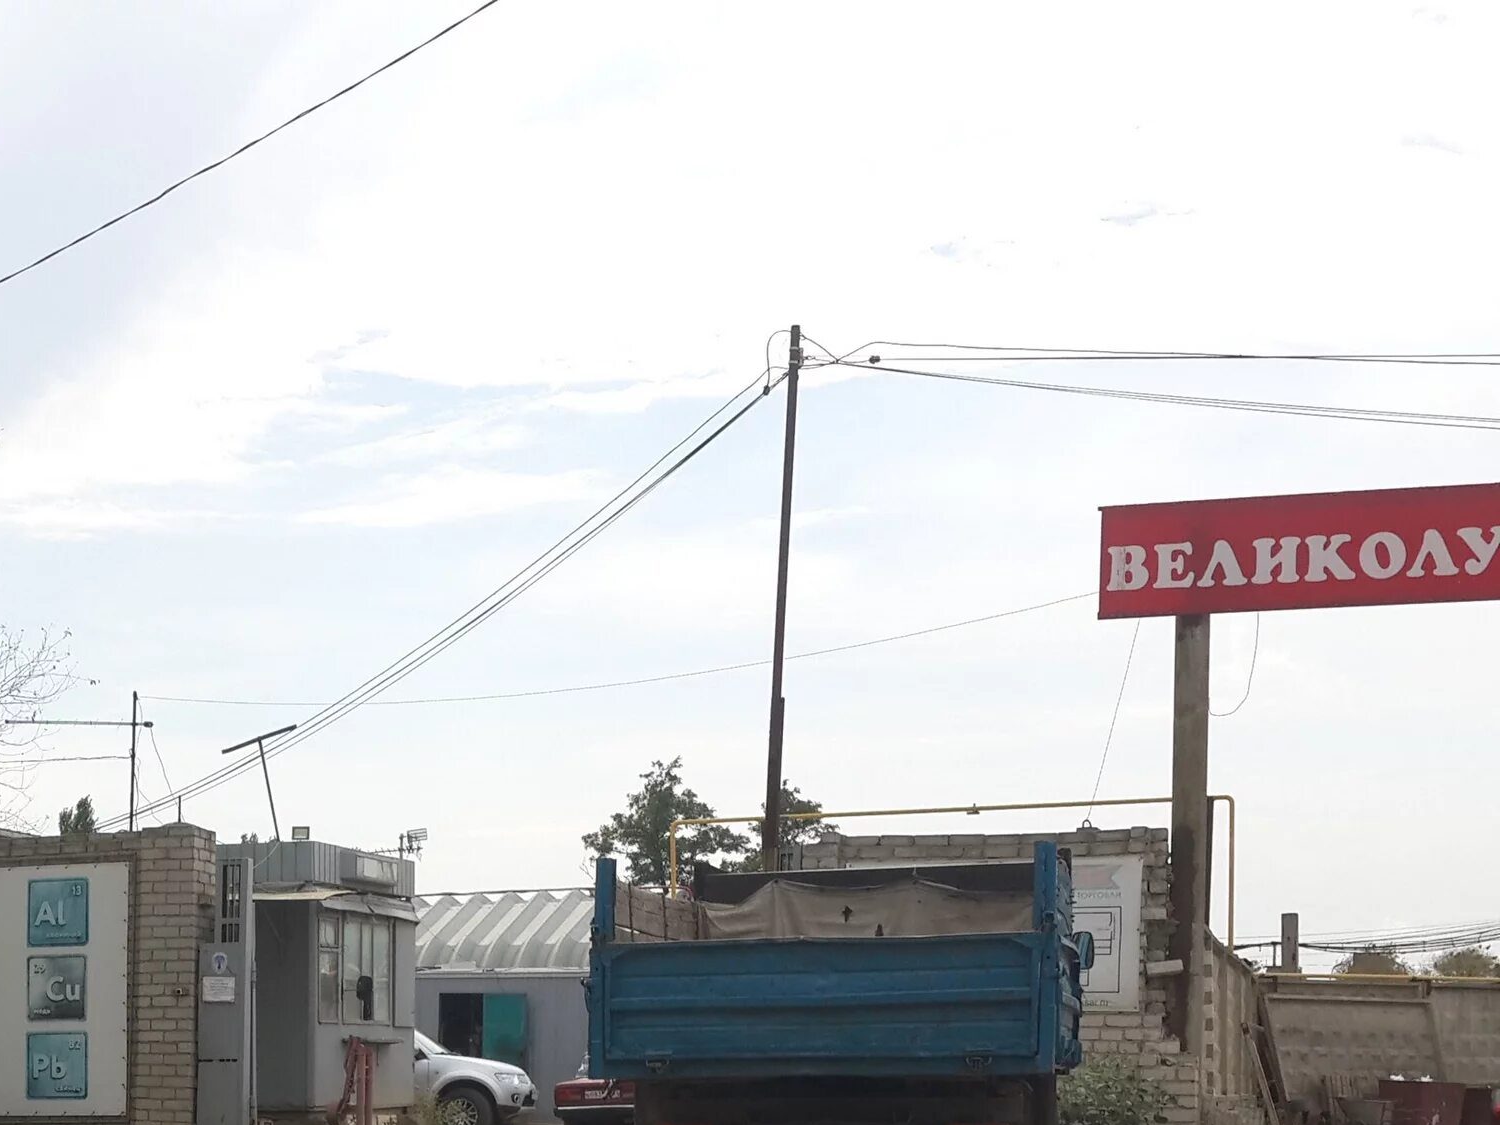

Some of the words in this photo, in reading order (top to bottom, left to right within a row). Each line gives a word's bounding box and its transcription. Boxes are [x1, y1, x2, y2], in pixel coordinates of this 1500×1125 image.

[1105, 526, 1500, 592] ВЕЛИКОЛУ
[71, 885, 83, 896] 13
[34, 899, 67, 926] Al
[45, 976, 81, 1002] Cu
[32, 1053, 68, 1080] Pb
